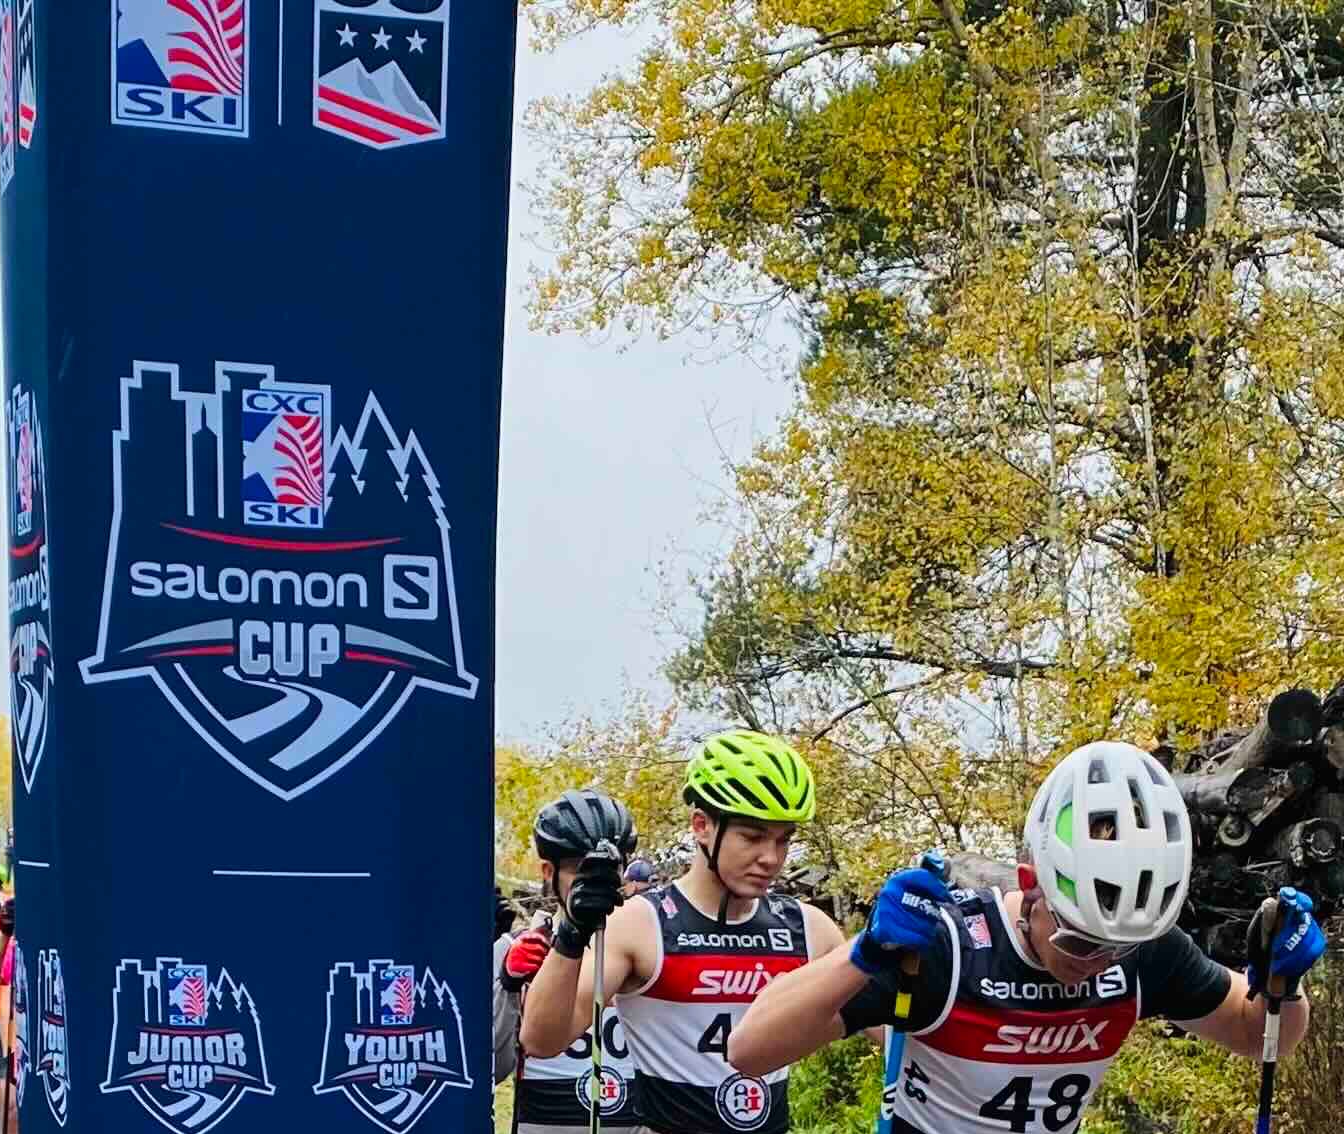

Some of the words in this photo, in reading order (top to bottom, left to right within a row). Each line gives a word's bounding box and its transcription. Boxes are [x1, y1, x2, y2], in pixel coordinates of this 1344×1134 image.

[125, 87, 236, 125] SKI
[246, 392, 319, 414] CXC
[248, 504, 320, 526] SKI
[129, 561, 369, 608] salomon
[239, 620, 340, 677] CUP
[677, 932, 767, 948] salomon
[980, 978, 1090, 1000] salomon
[128, 1032, 246, 1067] JUNIOR
[344, 1030, 447, 1065] YOUTH
[168, 1064, 214, 1088] CUP
[379, 1062, 418, 1086] CUP
[978, 1073, 1092, 1134] 48
